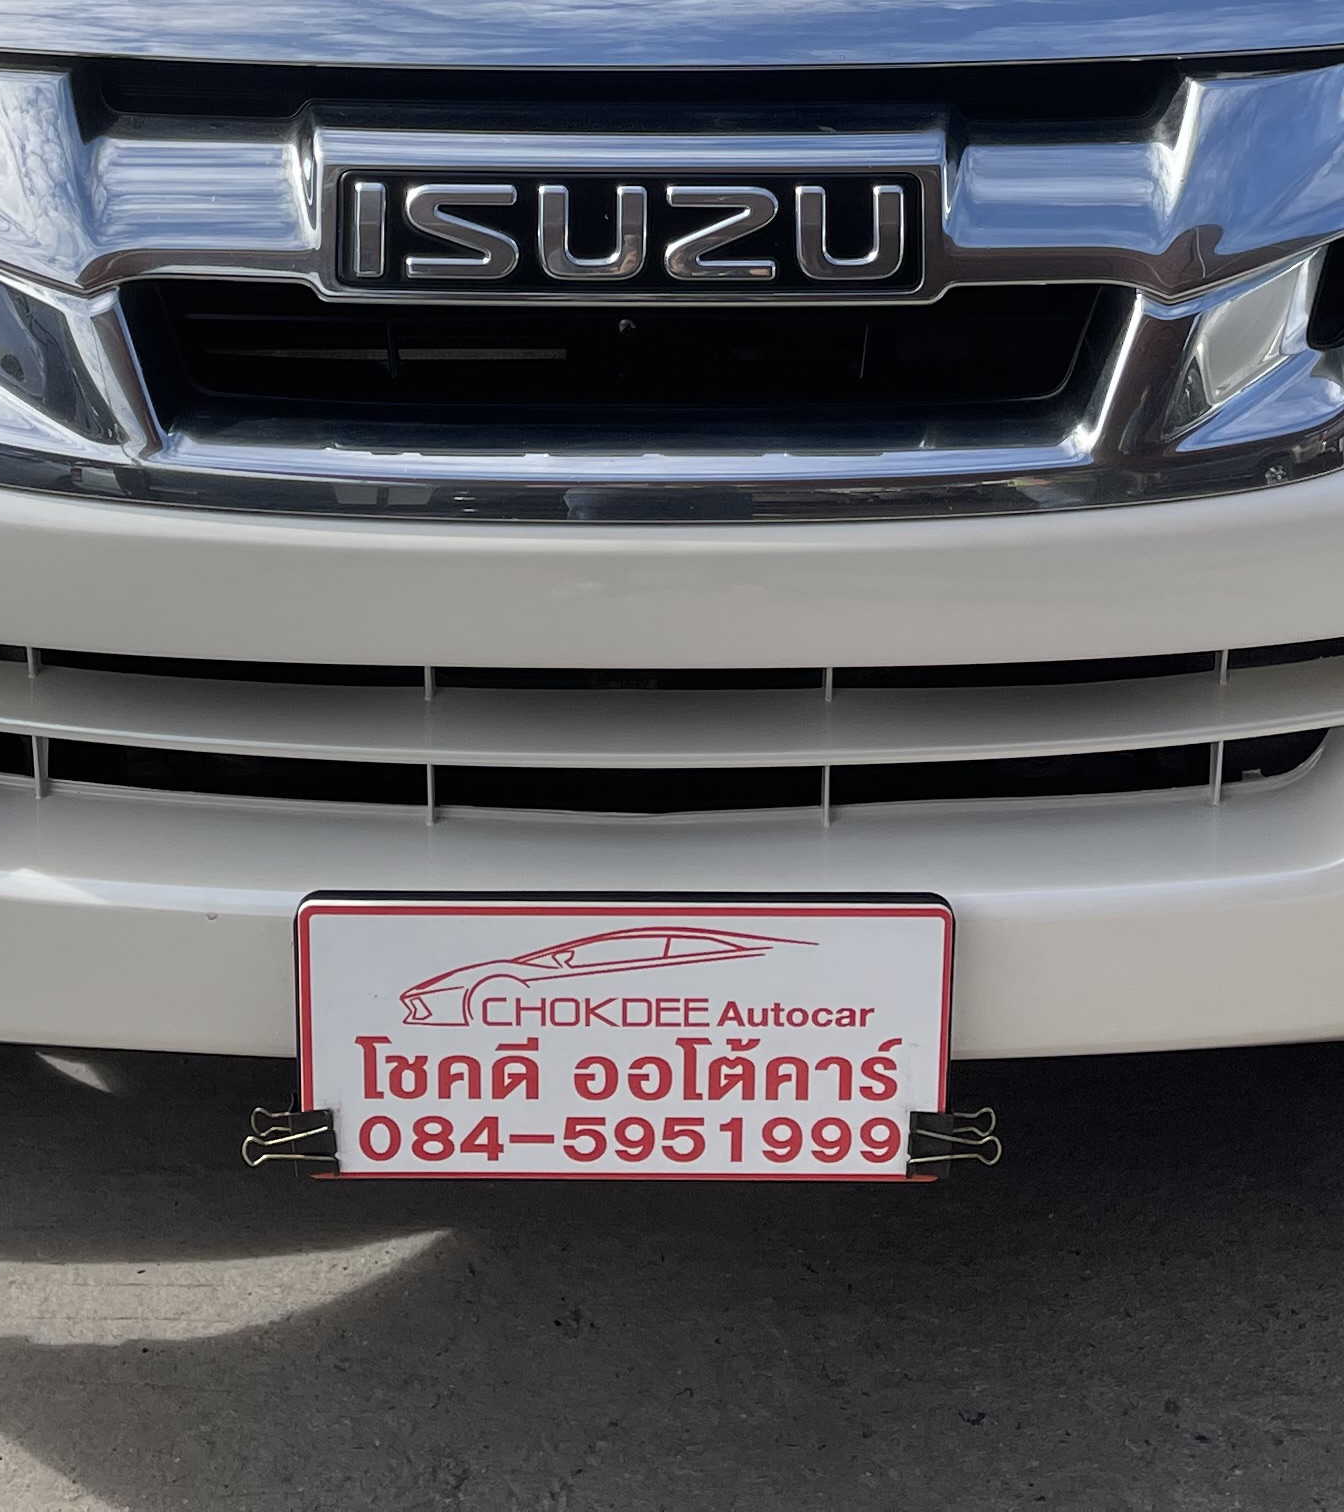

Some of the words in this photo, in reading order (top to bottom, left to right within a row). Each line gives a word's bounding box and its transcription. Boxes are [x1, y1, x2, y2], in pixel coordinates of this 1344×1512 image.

[355, 181, 905, 281] ISUZU
[481, 996, 711, 1029] CHOKDEE
[716, 999, 876, 1029] Autocar
[354, 1035, 540, 1101] โชคดี
[573, 1036, 904, 1102] ออโต้คาร์
[358, 1114, 903, 1164] 084-5951999
